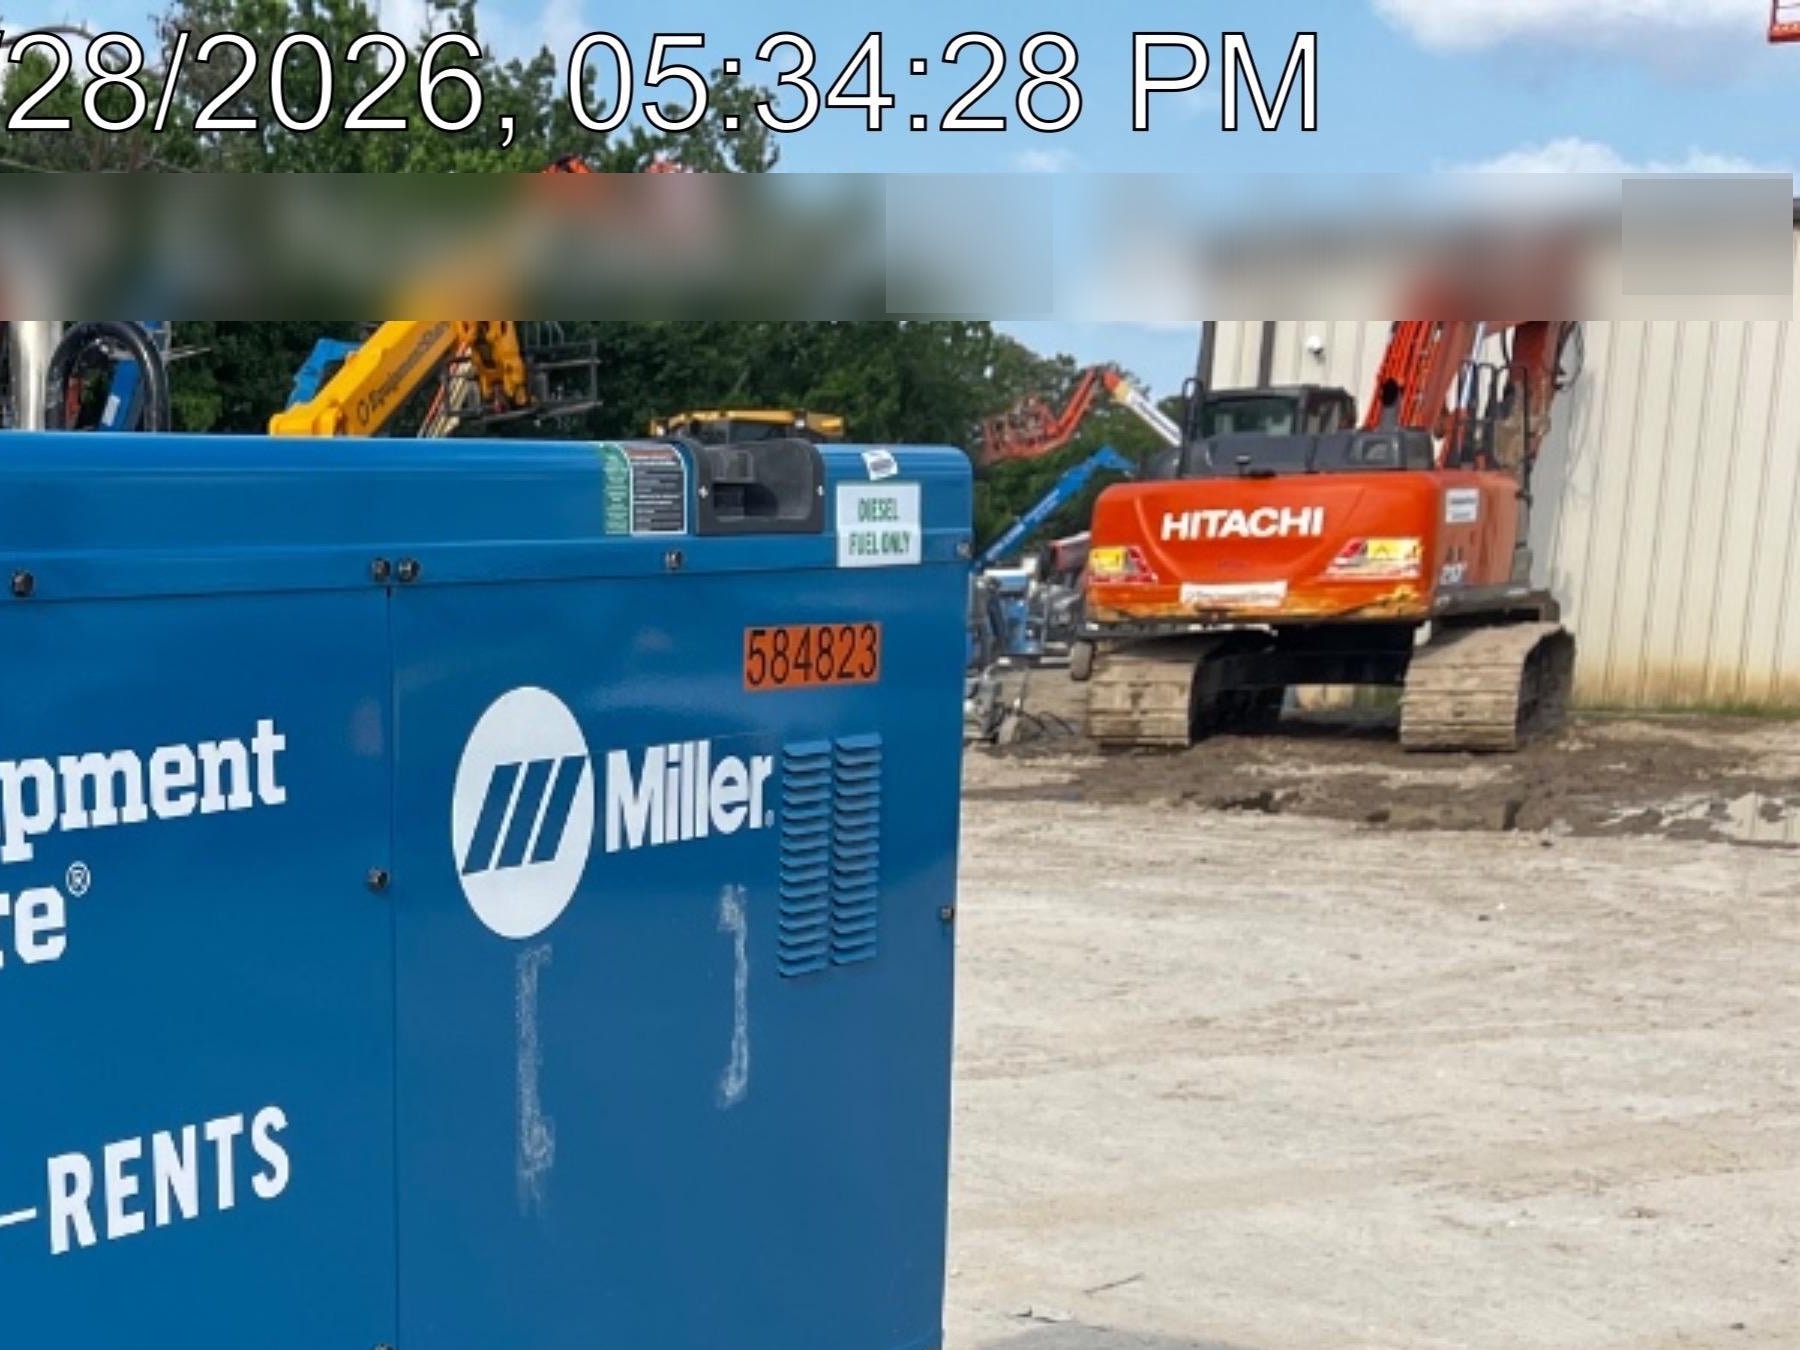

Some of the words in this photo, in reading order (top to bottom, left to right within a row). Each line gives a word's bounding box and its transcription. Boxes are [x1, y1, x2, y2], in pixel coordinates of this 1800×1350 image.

[858, 498, 899, 521] DIESEL
[1161, 506, 1324, 541] HITACHI
[747, 623, 879, 686] 584823
[605, 739, 774, 853] Miller
